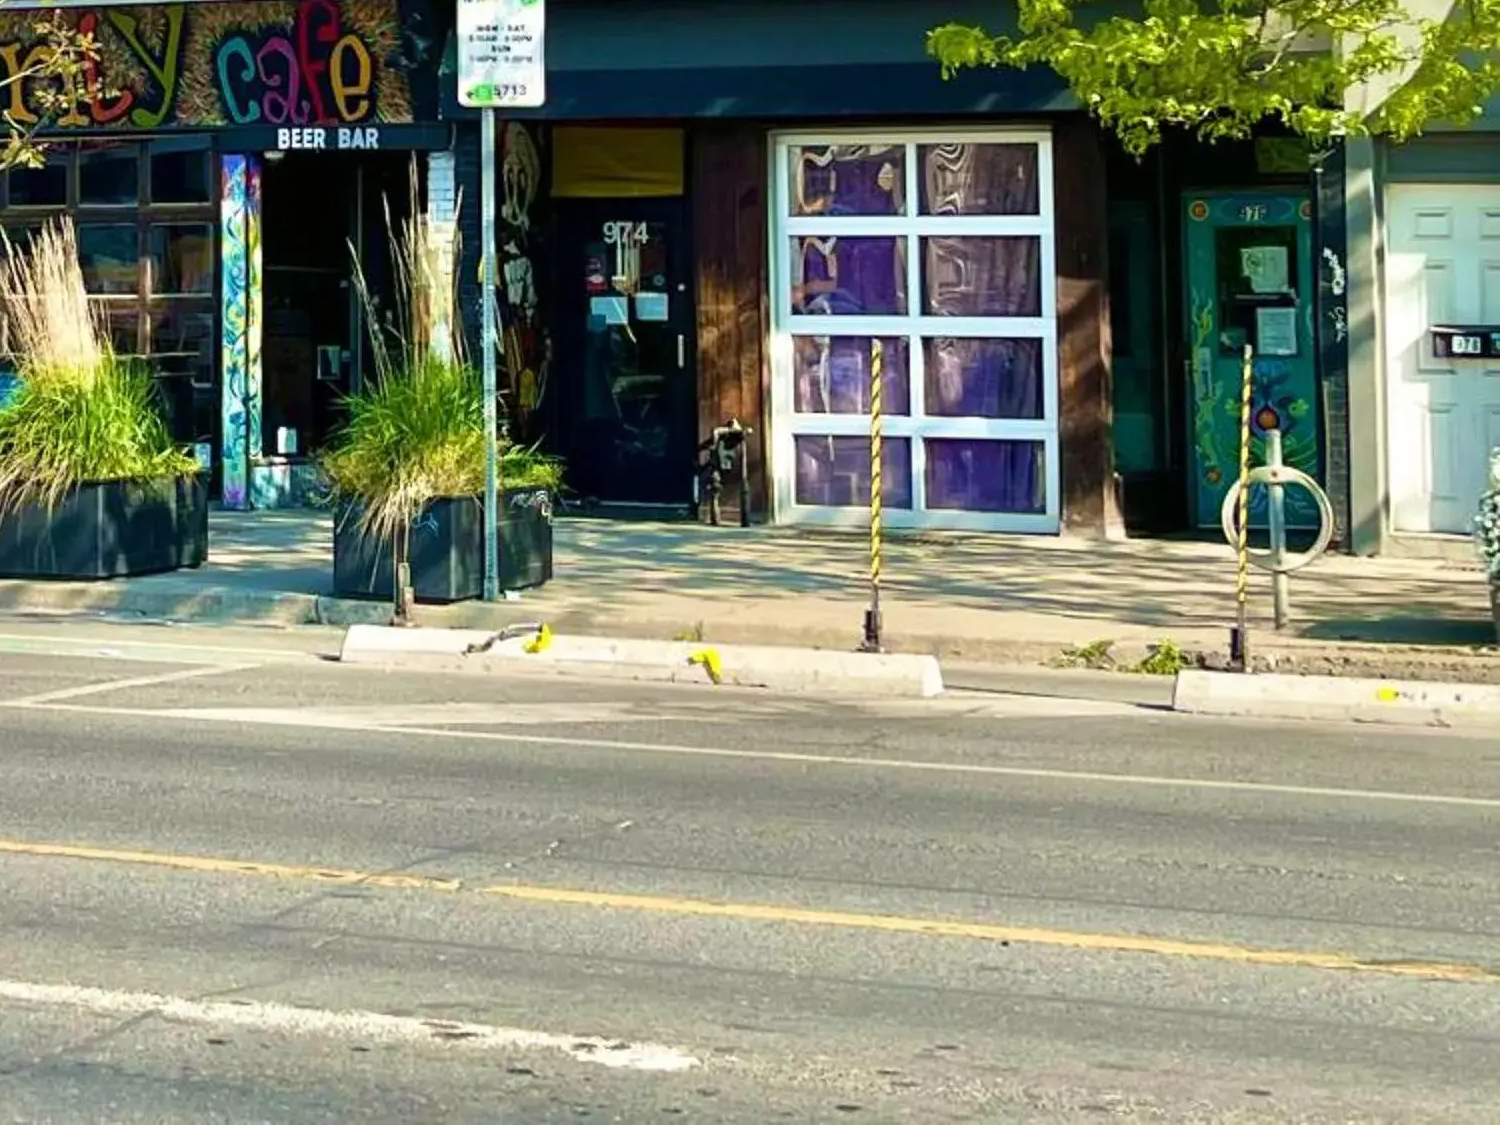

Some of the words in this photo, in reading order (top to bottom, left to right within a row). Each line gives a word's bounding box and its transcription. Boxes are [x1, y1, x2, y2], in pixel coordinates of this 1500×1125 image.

[217, 0, 372, 125] cafe
[277, 127, 327, 150] BEER
[338, 127, 380, 150] BAR
[603, 221, 650, 244] 974
